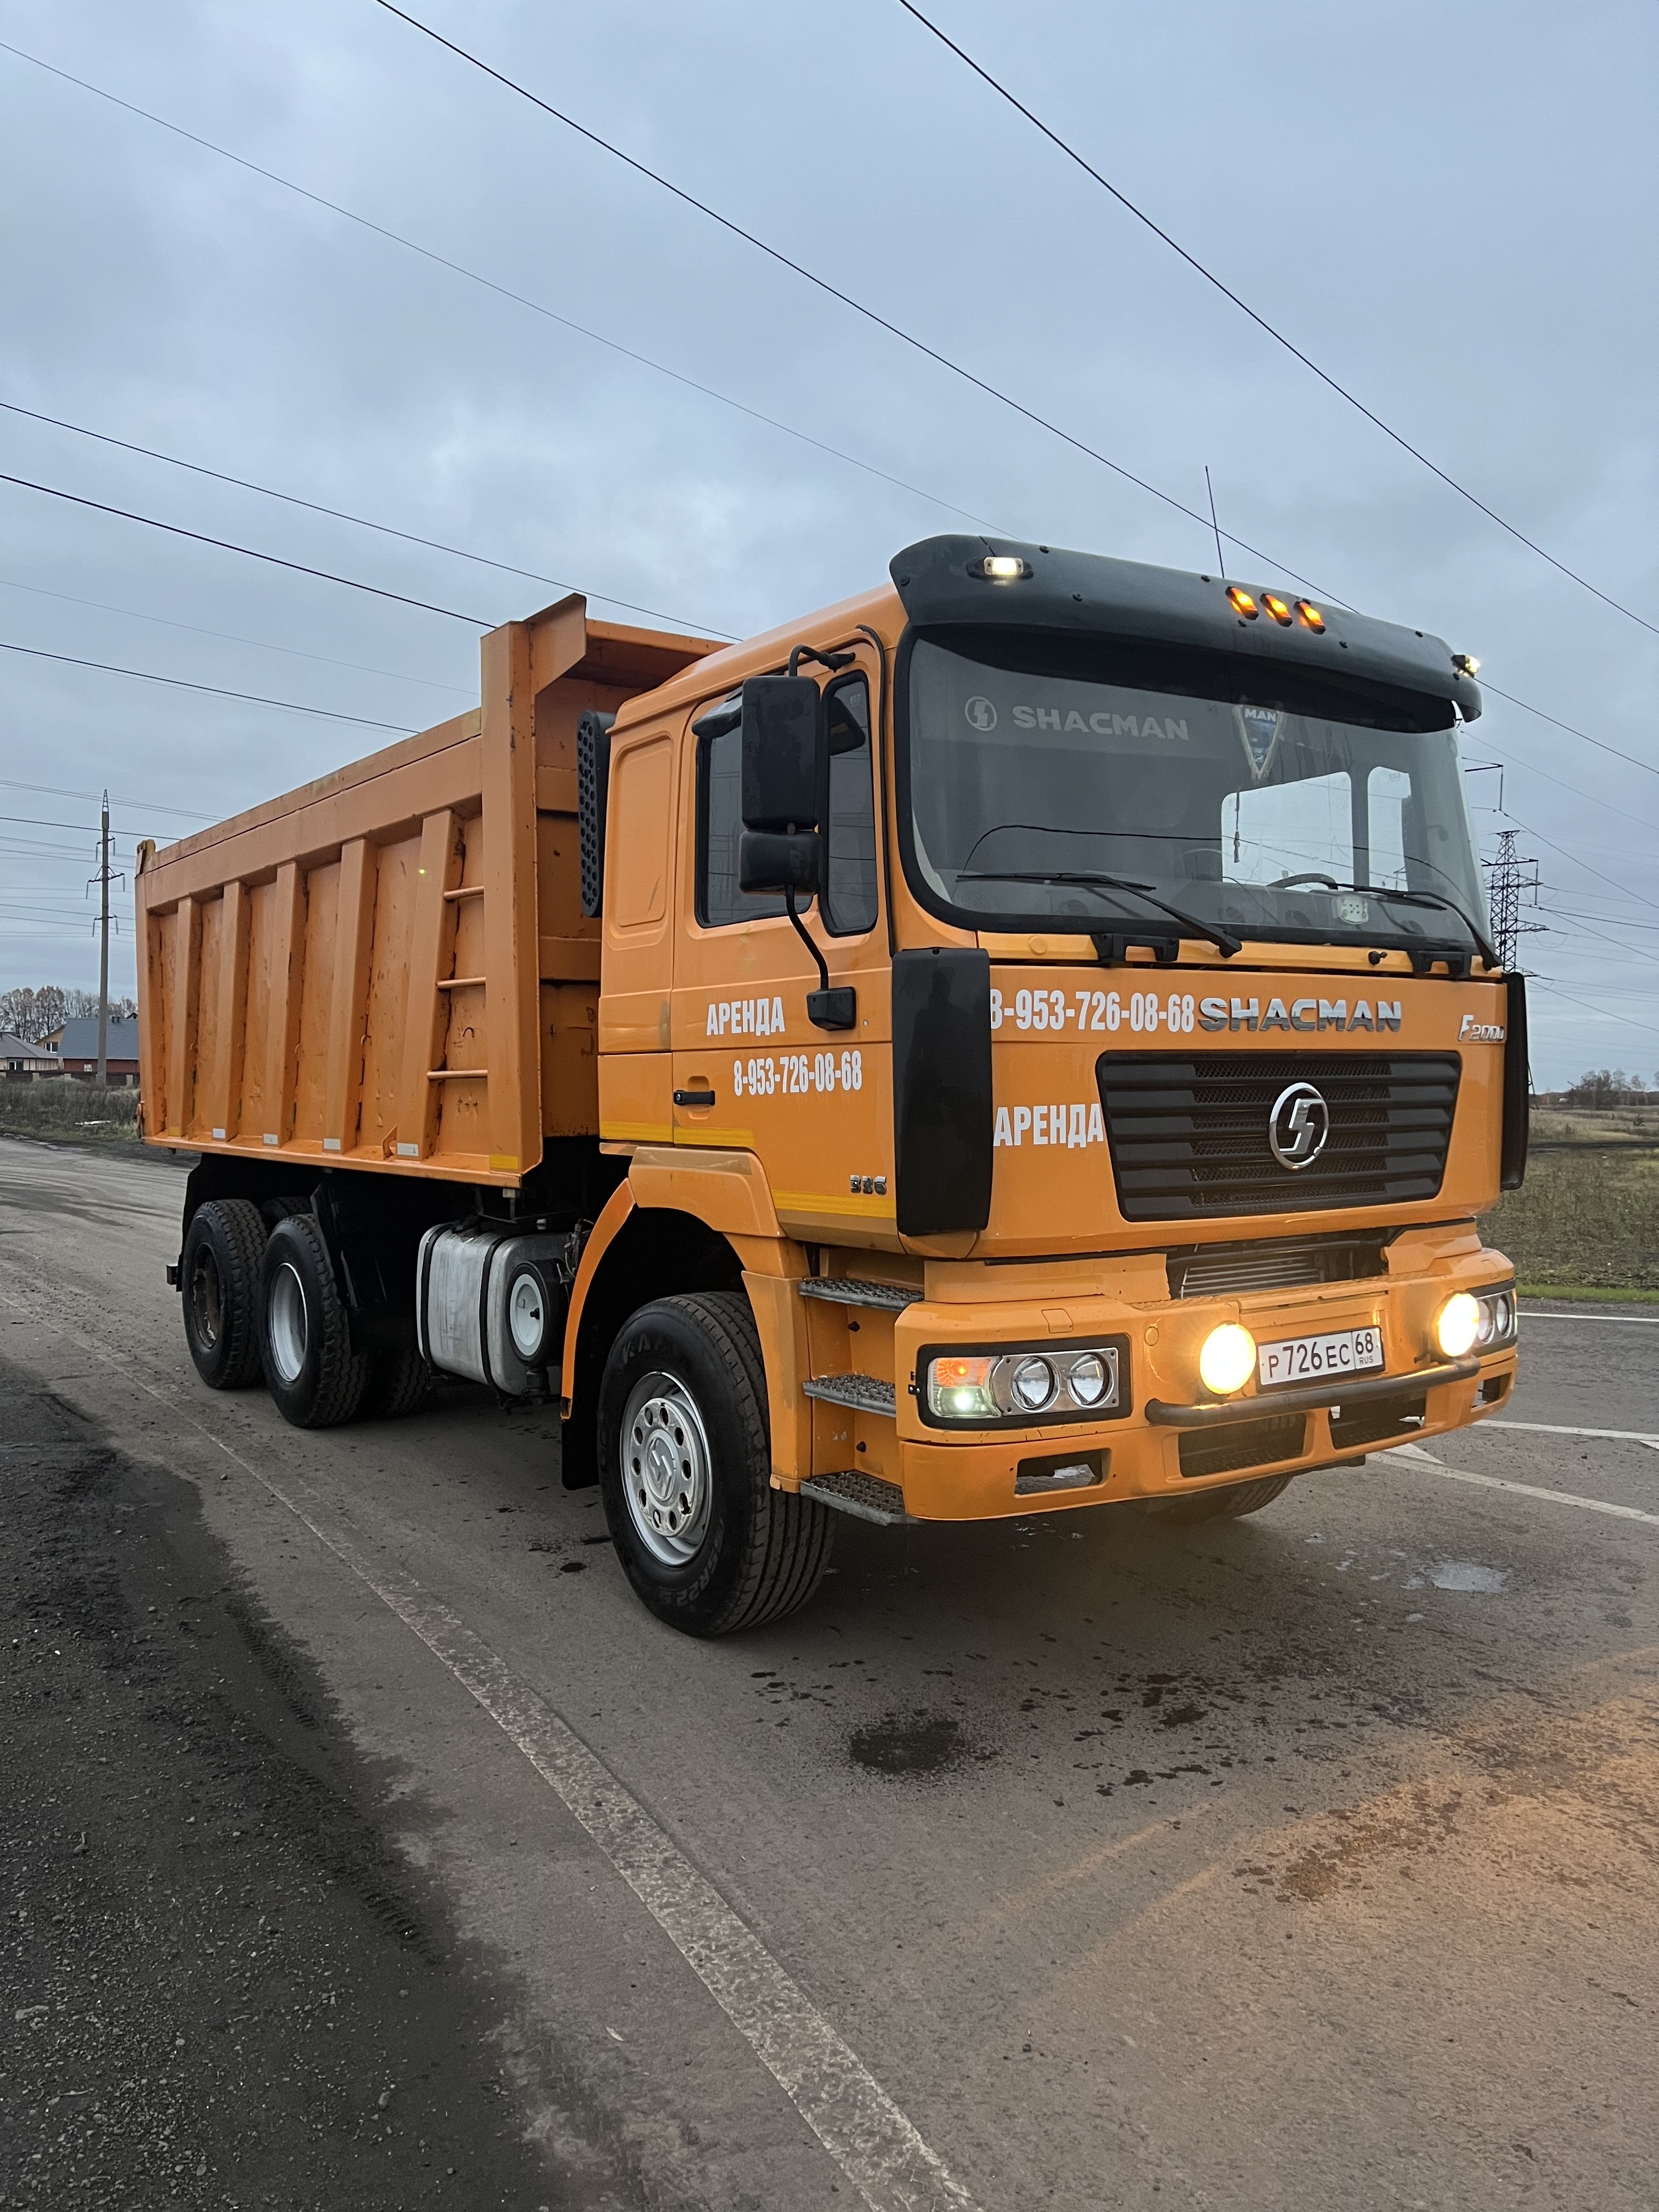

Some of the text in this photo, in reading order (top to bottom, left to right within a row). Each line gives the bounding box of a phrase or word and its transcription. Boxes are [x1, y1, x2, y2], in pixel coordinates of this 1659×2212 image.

[1012, 706, 1190, 741] SHACMAN
[1245, 708, 1277, 722] MAN
[707, 997, 785, 1036] АРЕНДА
[990, 989, 1194, 1032] 8-953-726-08-68
[1198, 997, 1401, 1032] SHACMAN
[734, 1050, 862, 1096] 8-953-726-08-68
[994, 1103, 1104, 1148] АРЕНДА
[1355, 1332, 1374, 1355] 68
[1359, 1355, 1374, 1365] RUS
